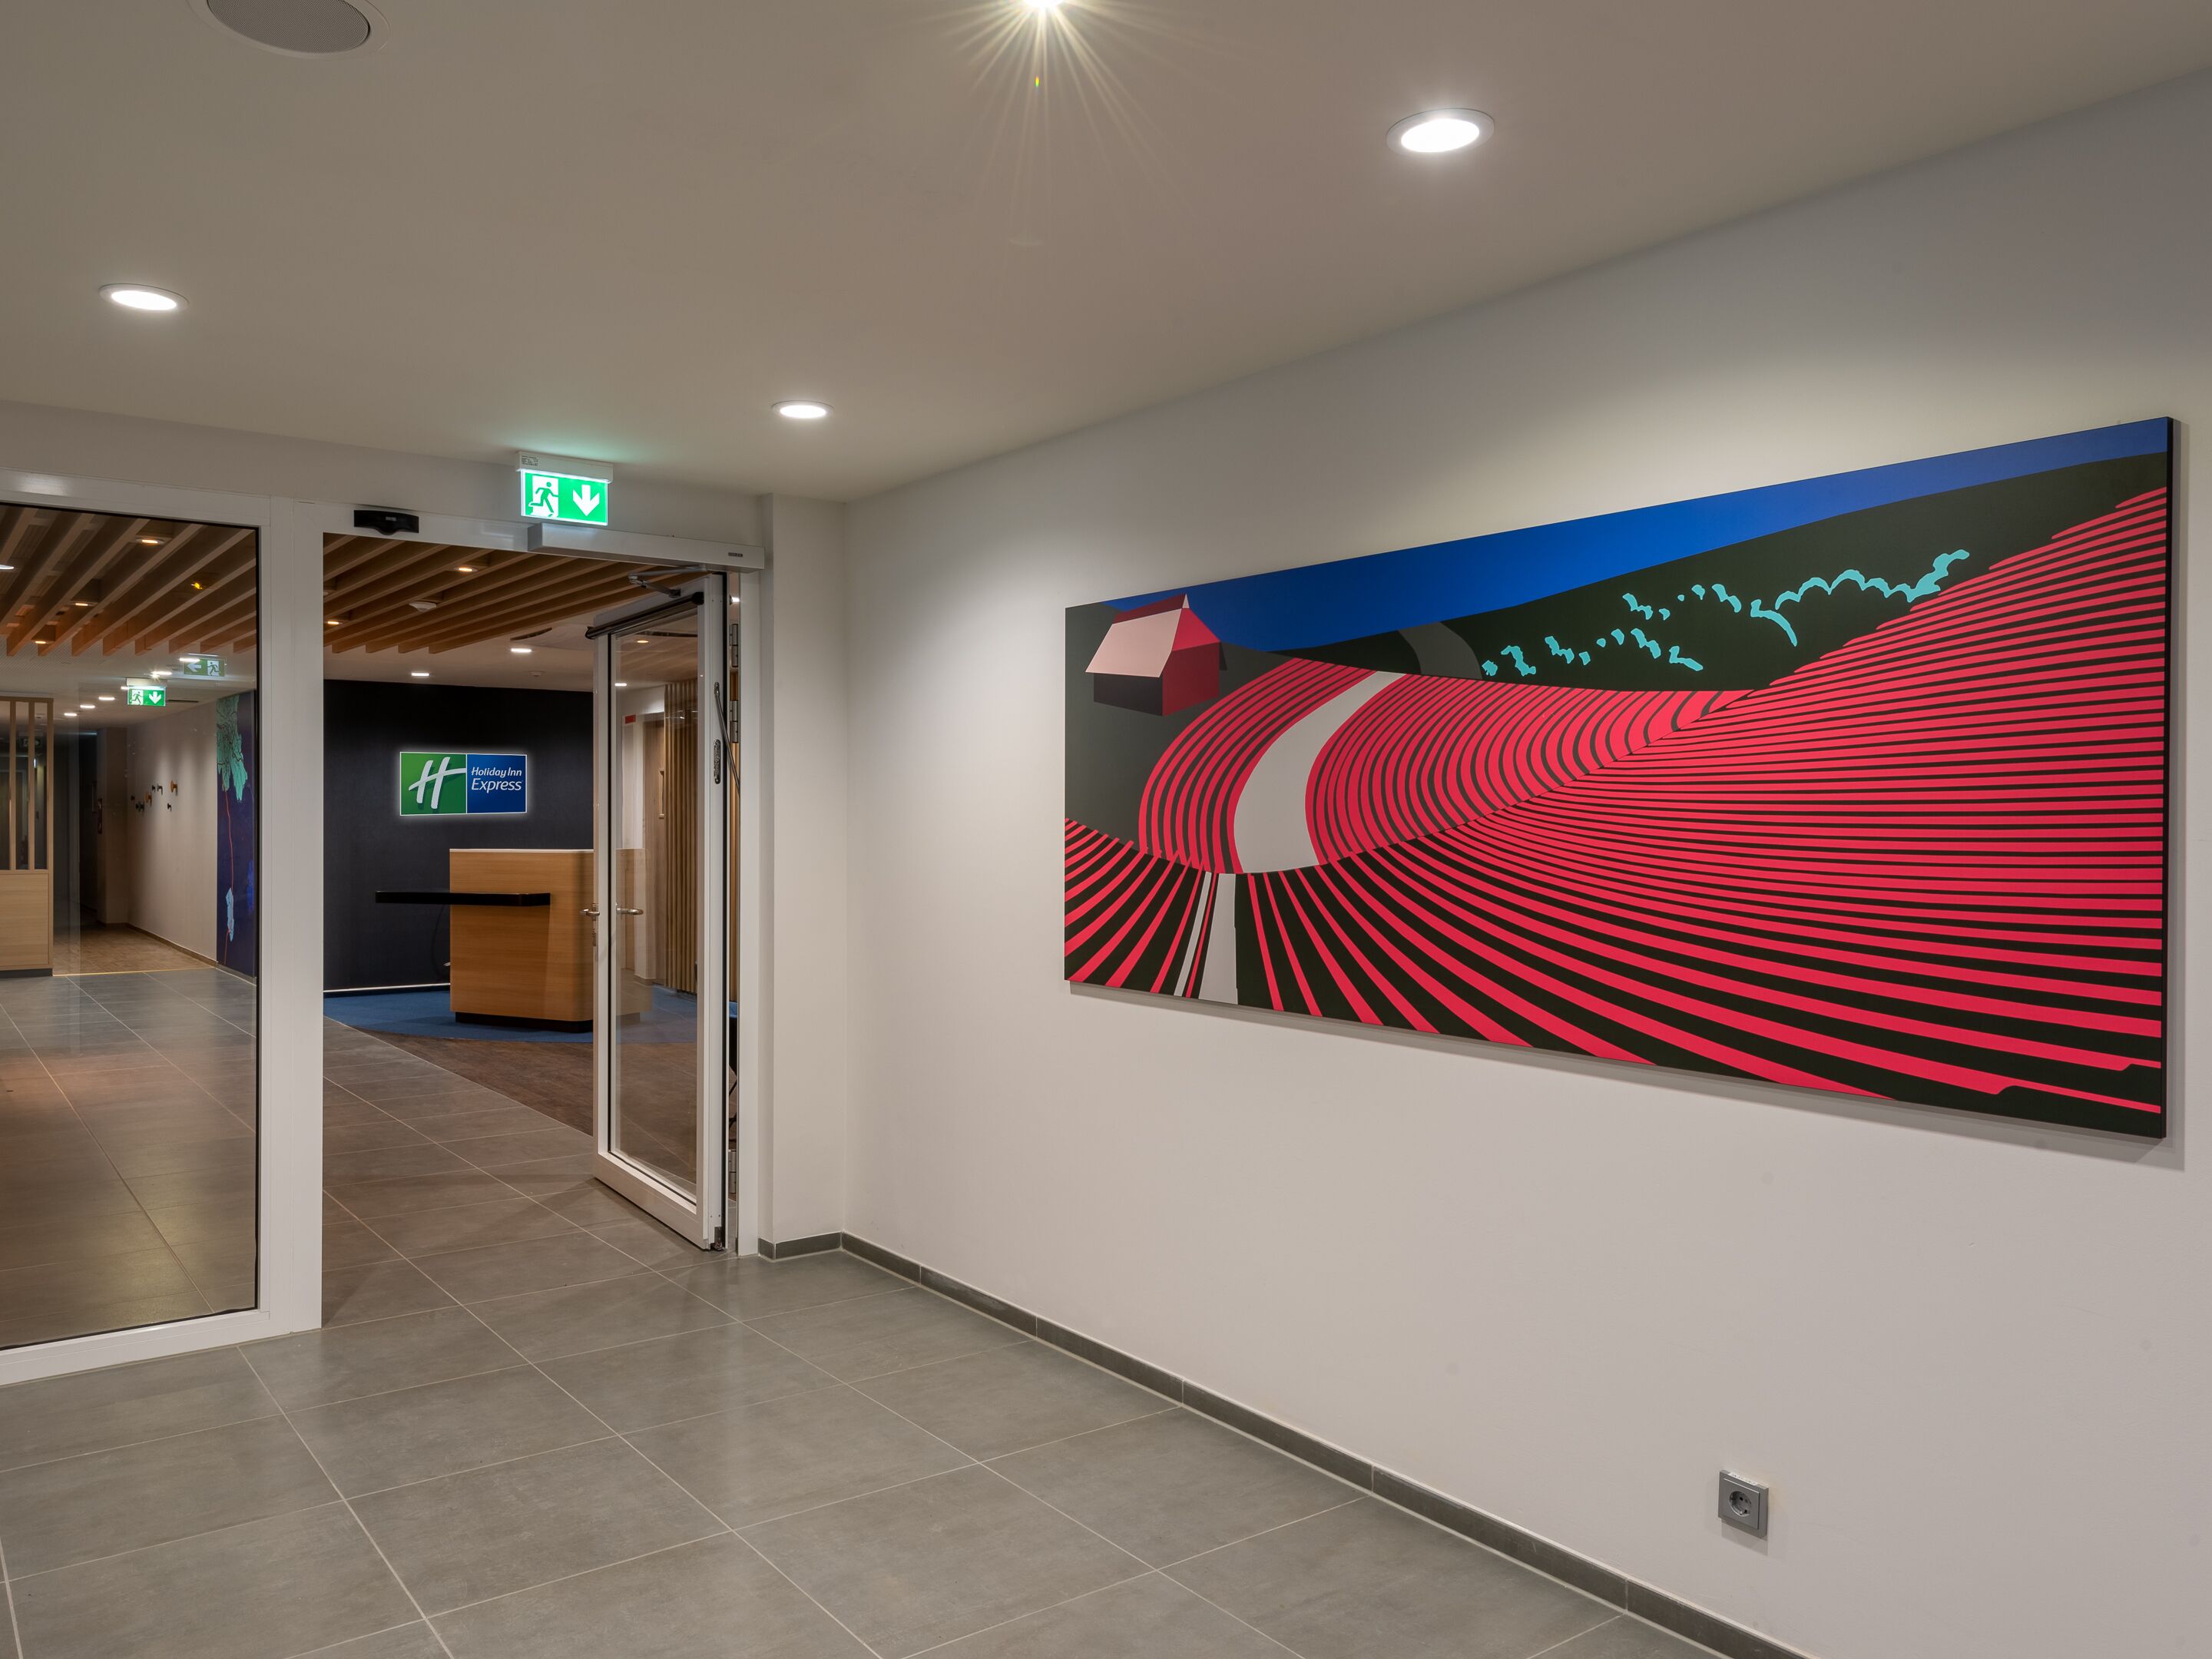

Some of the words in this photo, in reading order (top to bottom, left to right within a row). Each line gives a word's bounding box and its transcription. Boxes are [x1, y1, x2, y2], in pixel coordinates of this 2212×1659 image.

[471, 767, 507, 778] Holiday
[507, 767, 522, 777] Inn
[471, 777, 522, 793] Express
